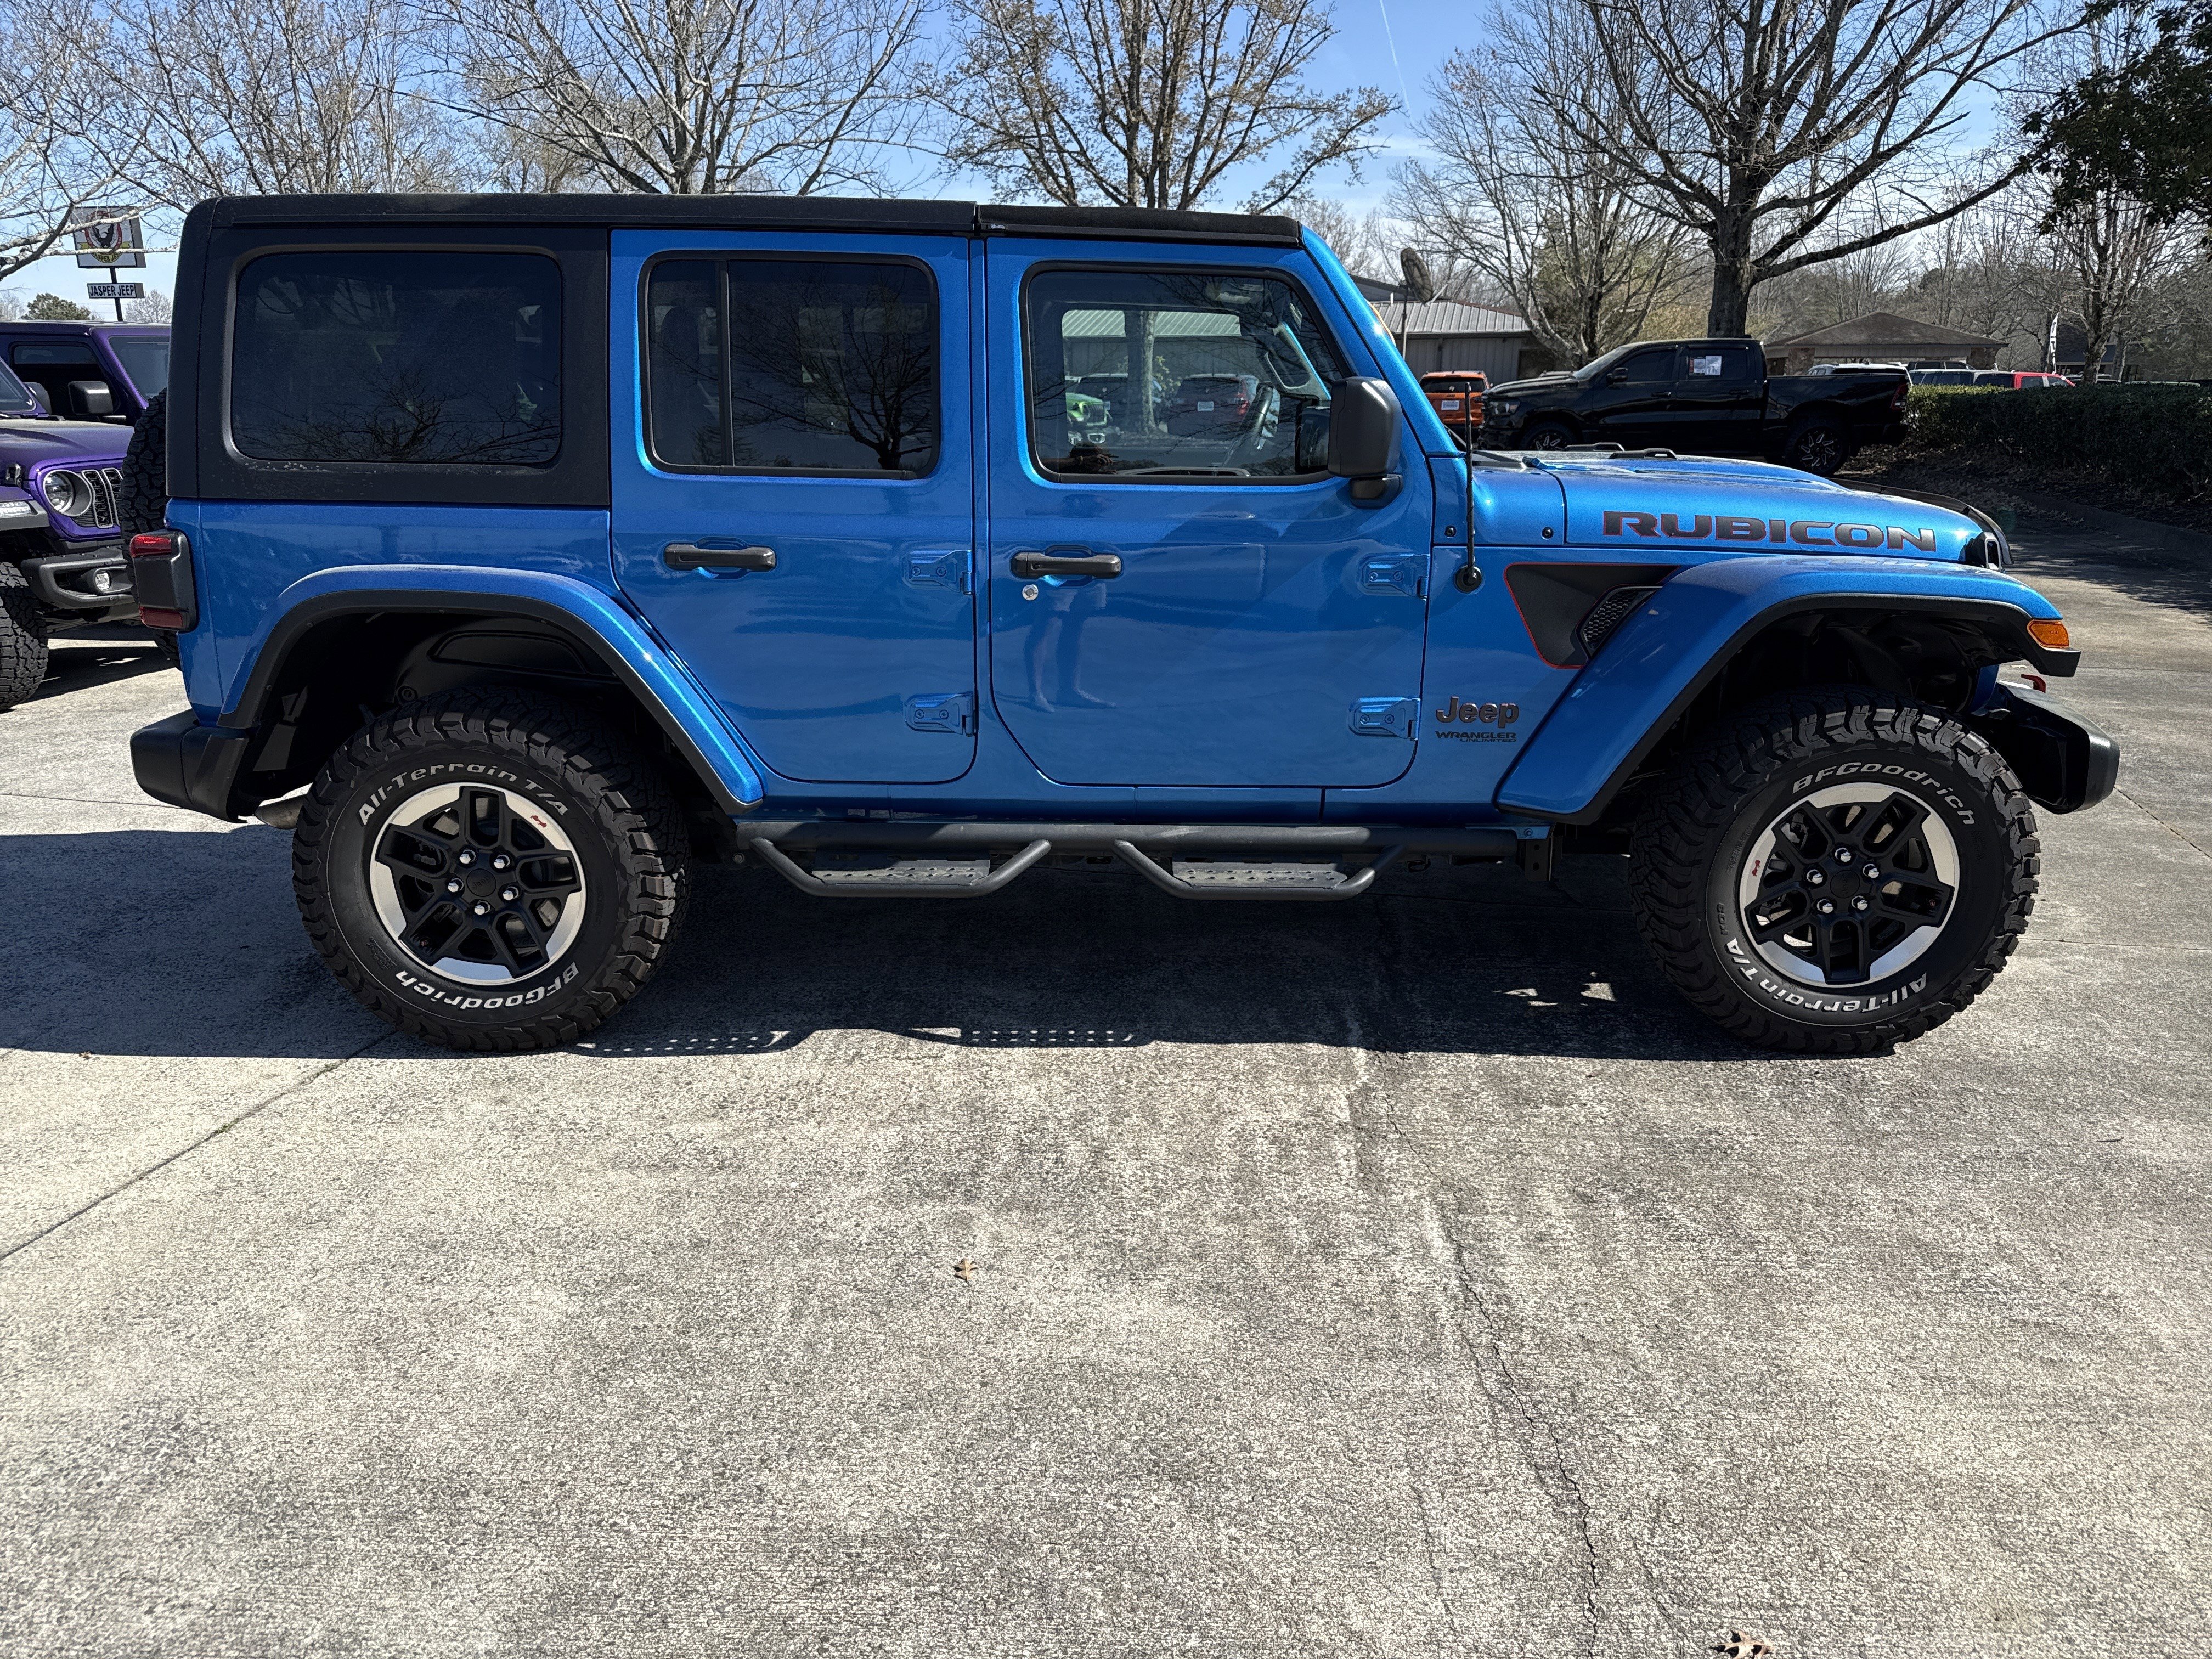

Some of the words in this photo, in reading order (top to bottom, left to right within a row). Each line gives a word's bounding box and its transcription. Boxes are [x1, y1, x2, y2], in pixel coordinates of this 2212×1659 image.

[90, 286, 116, 296] JASPER
[117, 285, 134, 296] JEEP
[1602, 511, 1937, 551] RUBICON
[1436, 696, 1519, 729] Jeep
[359, 763, 517, 826] All-Terrain
[524, 778, 568, 816] T/A
[1792, 761, 1975, 825] BFGoodrich
[1726, 938, 1758, 981] T/A
[396, 961, 579, 1010] BFGoodrich
[1759, 972, 1927, 1013] All-Terrain
